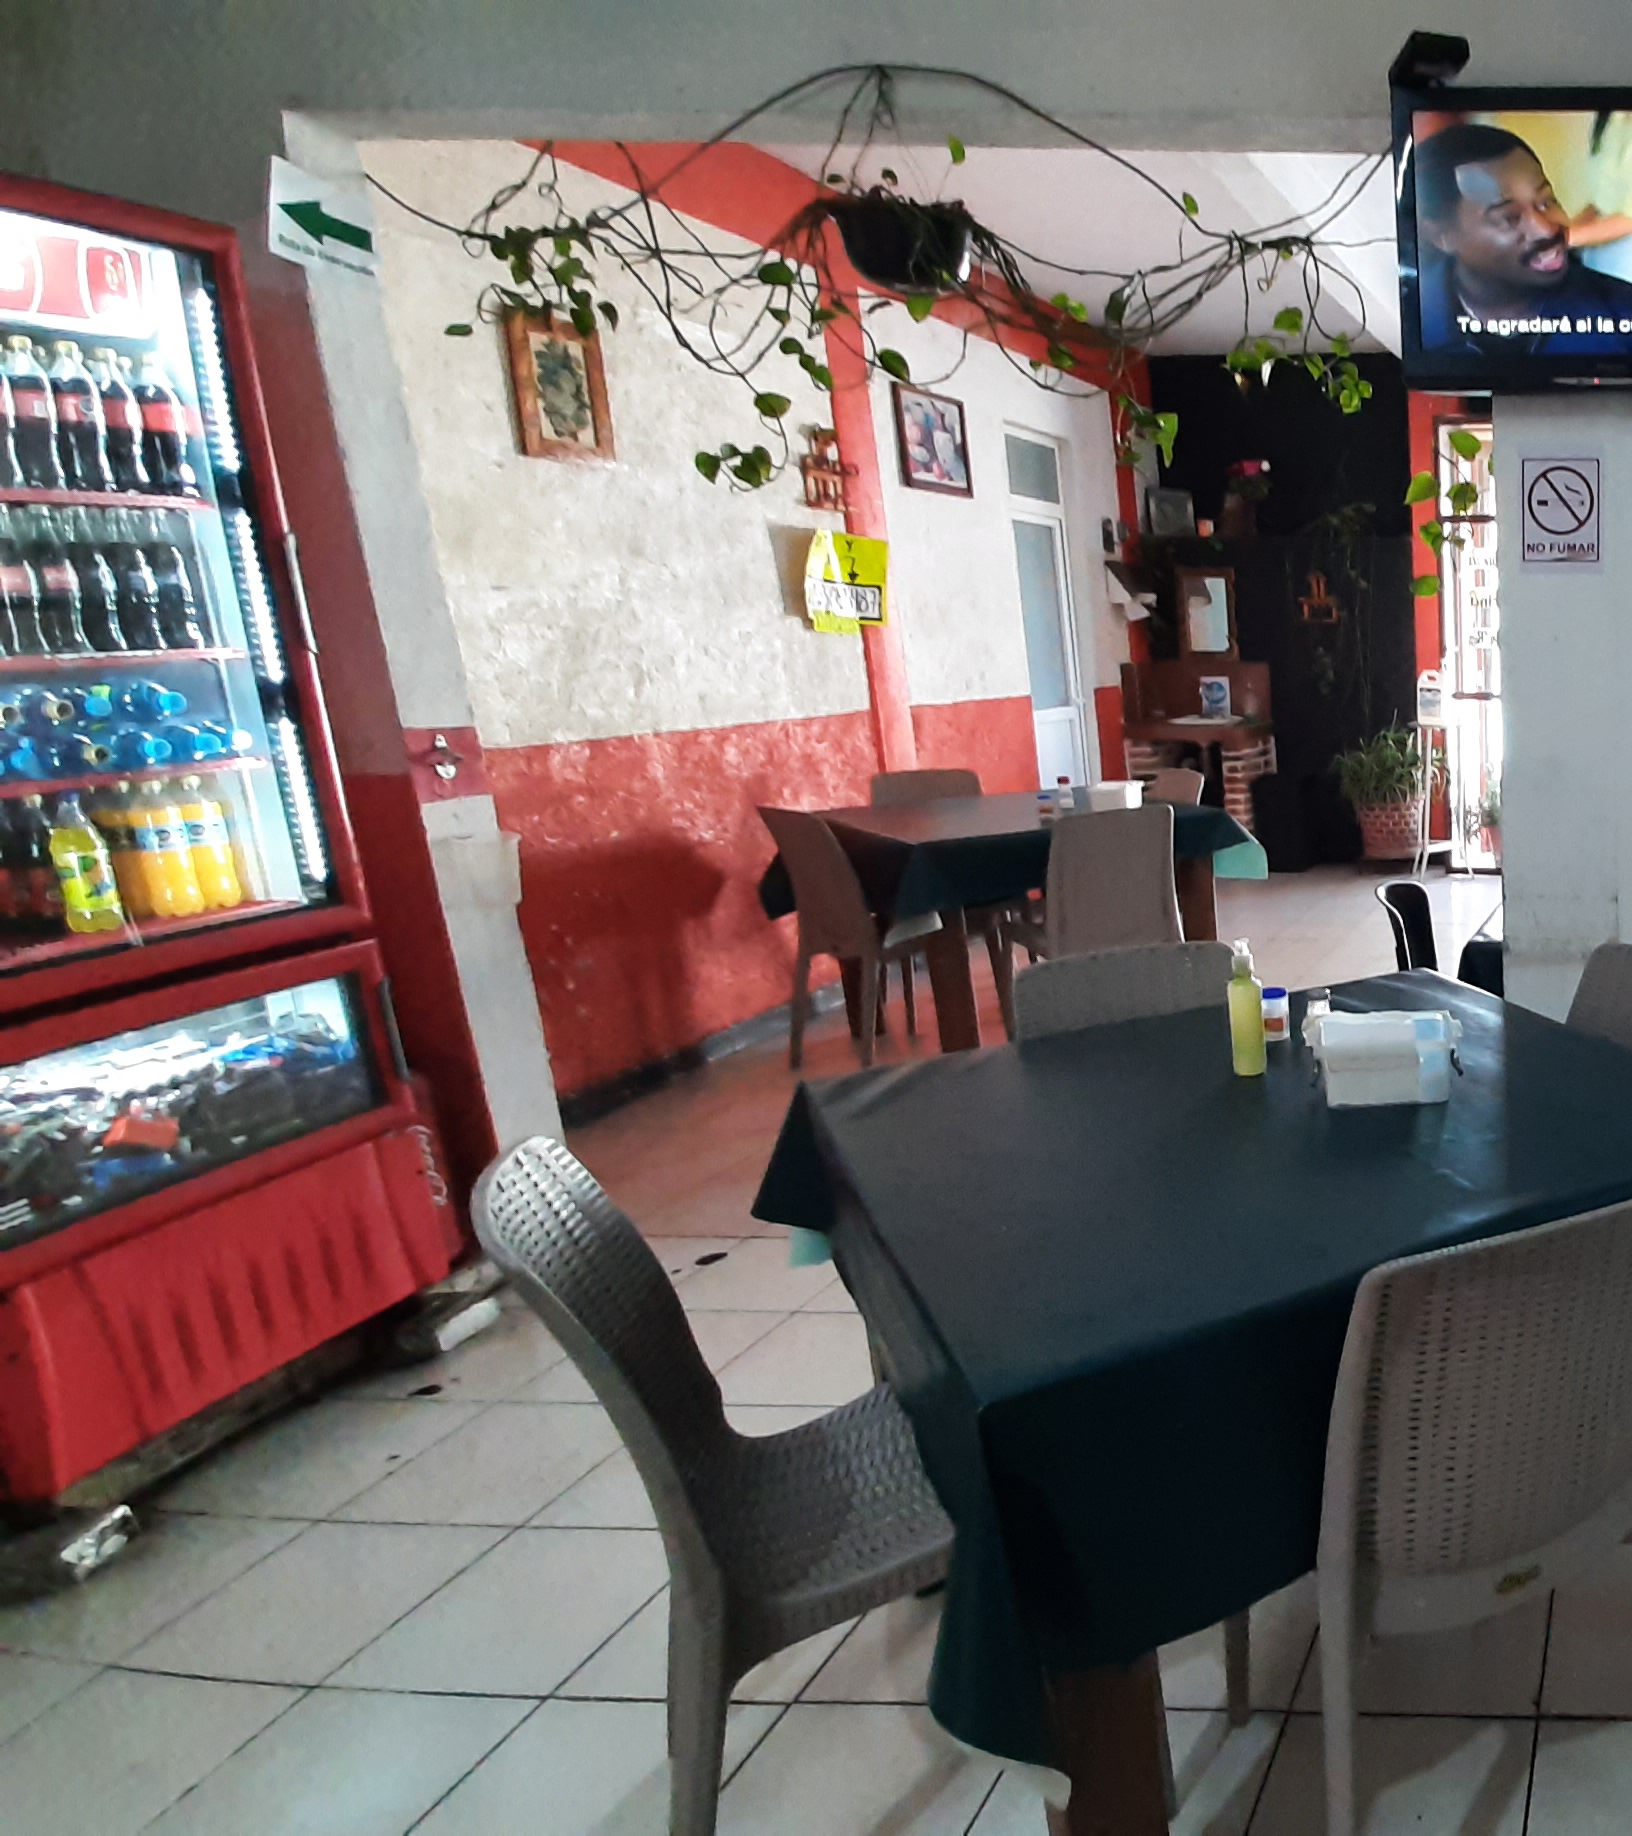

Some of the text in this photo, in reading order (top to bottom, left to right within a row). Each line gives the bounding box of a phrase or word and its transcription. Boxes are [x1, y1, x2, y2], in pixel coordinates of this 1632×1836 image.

[1457, 315, 1483, 334] Te
[1486, 315, 1572, 338] agradará
[1576, 316, 1592, 333] si
[1597, 316, 1615, 333] la
[1527, 543, 1595, 553] NO FUMAR
